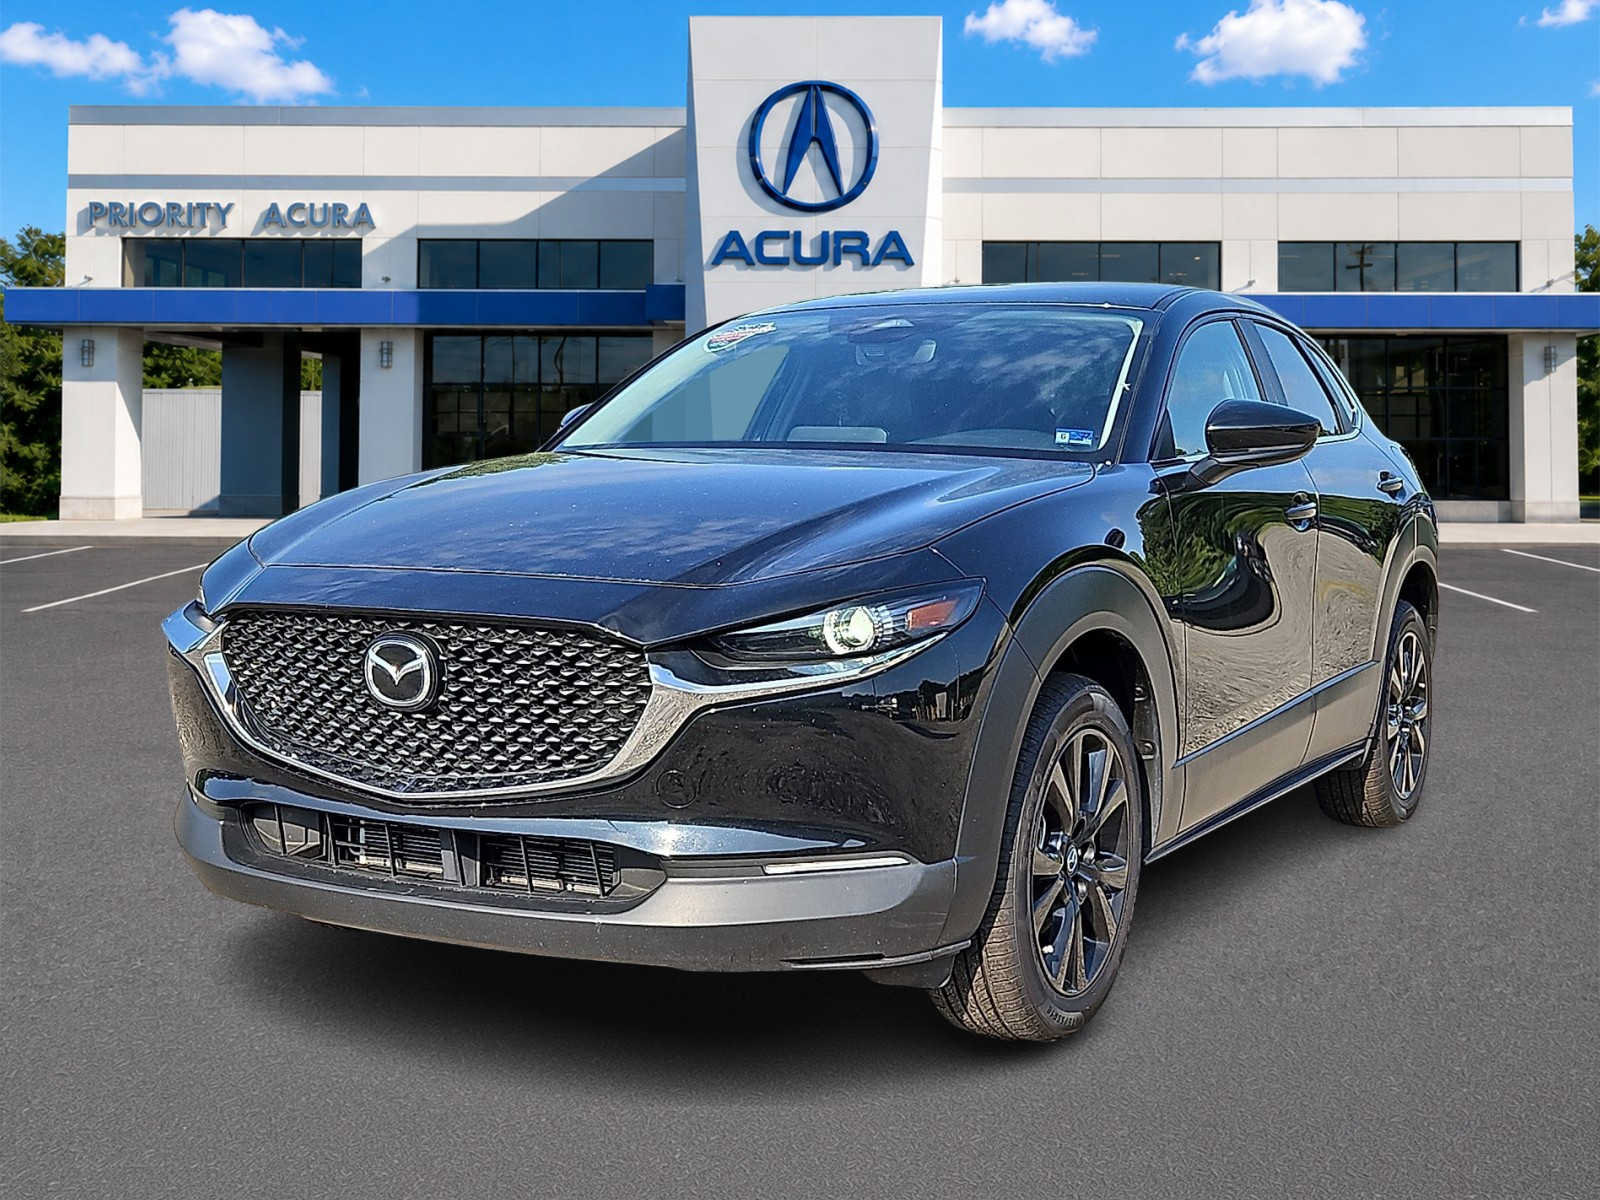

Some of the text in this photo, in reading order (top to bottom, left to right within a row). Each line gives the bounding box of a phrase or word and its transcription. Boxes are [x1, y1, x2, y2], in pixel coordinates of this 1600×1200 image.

[88, 202, 376, 228] PRIORITY ACURA
[711, 230, 915, 266] ACURA
